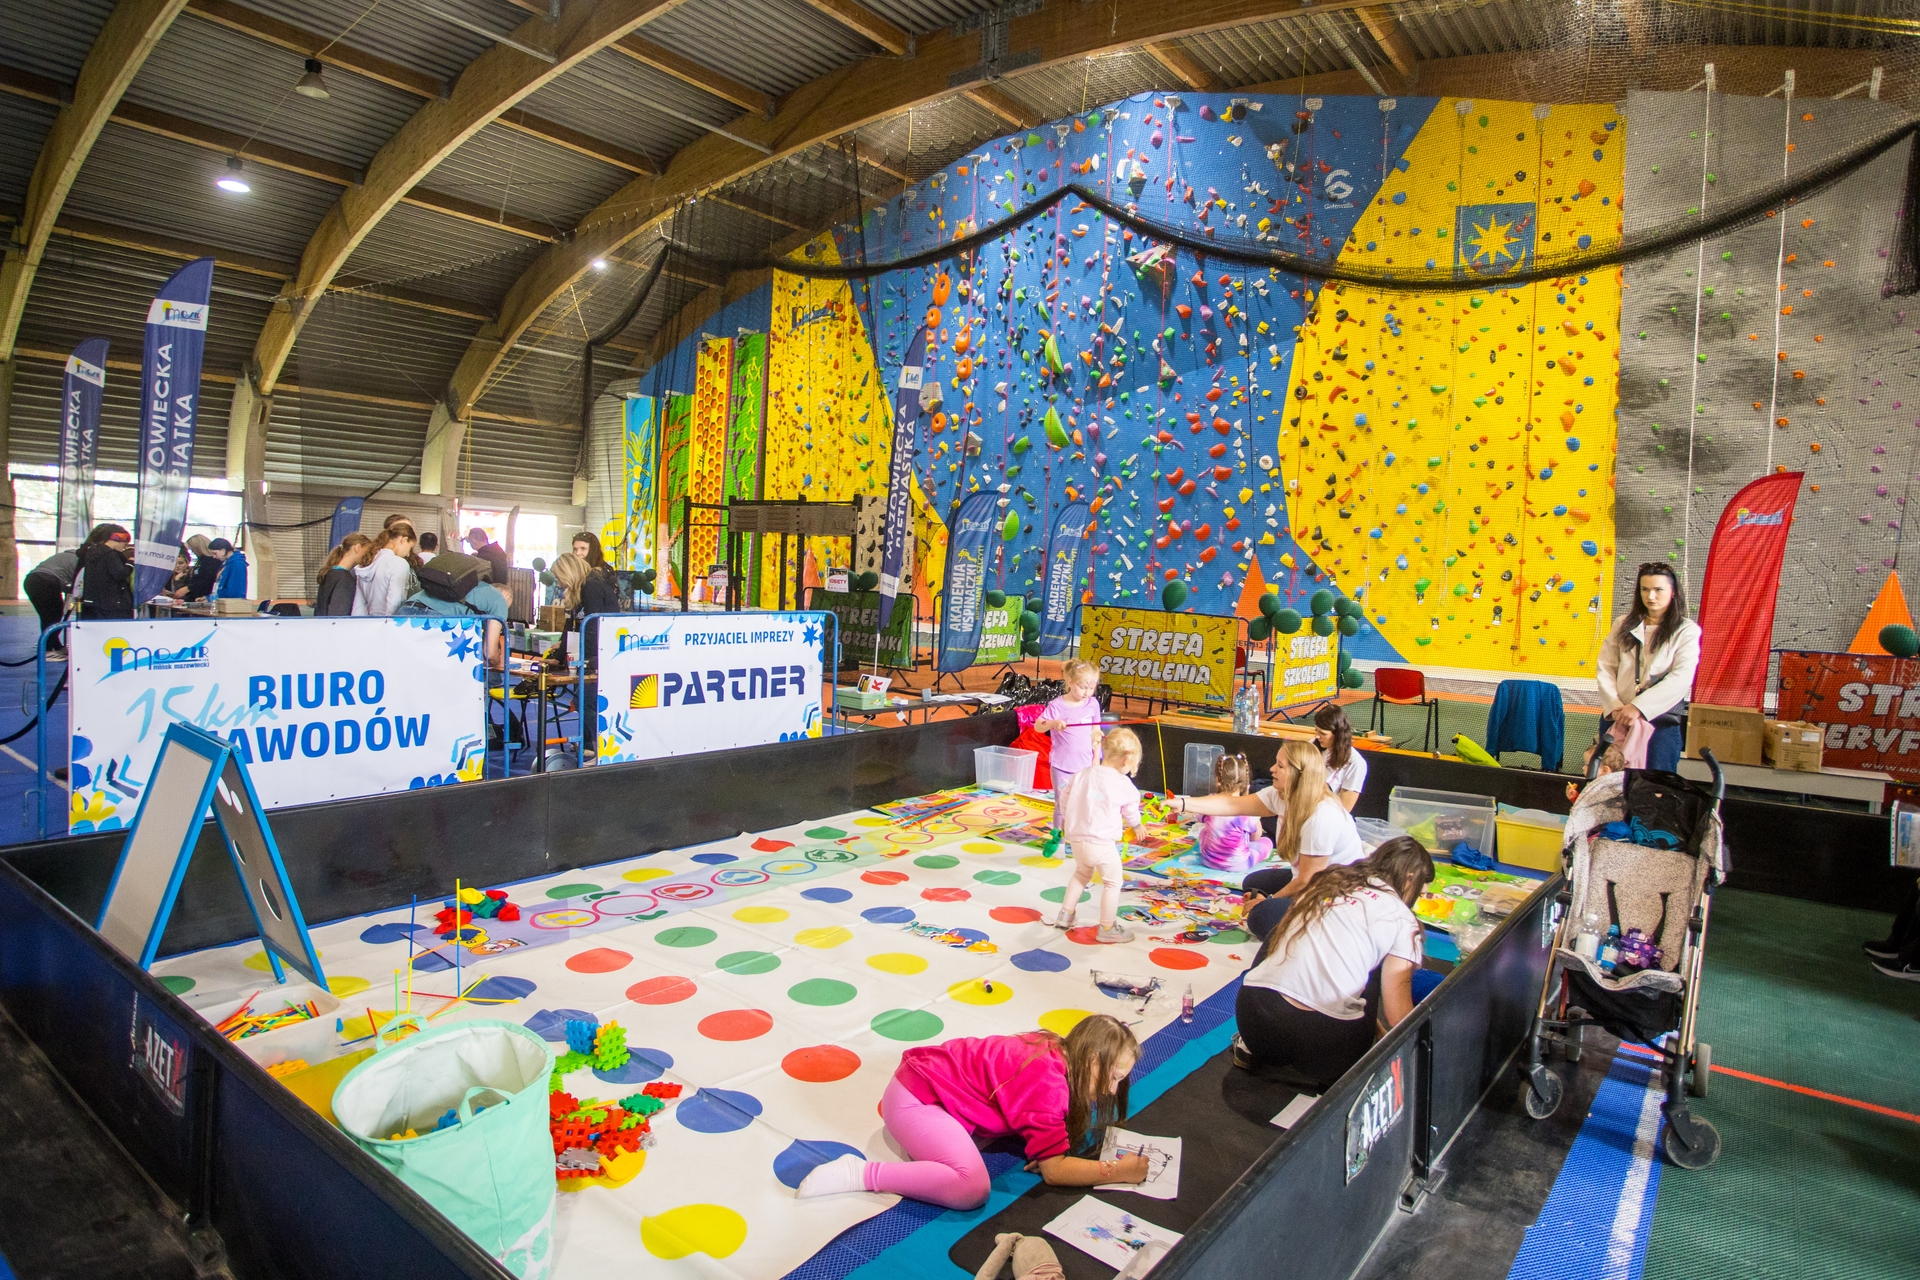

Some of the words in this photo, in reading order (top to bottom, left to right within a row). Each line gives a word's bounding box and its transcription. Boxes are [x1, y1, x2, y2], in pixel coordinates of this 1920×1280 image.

[886, 404, 907, 560] MAZOWIECKA
[949, 563, 966, 632] AKADEMIA
[962, 563, 977, 633] WSPINACZKI
[1046, 563, 1062, 622] AKADEMIA
[1056, 564, 1072, 622] WSPINACZKI
[831, 605, 890, 628] STREF
[685, 631, 748, 646] PRZYJACIEL
[750, 630, 795, 644] IMPREZY
[1110, 626, 1203, 658] STREFA
[1289, 635, 1328, 660] STREFA
[249, 669, 385, 712] BIURO
[663, 665, 806, 707] PARTNER
[1099, 655, 1211, 686] SZKOLENIA
[1283, 661, 1330, 688] SZKOLENIA
[206, 707, 431, 765] AWODÓW
[1797, 720, 1920, 755] ERYF
